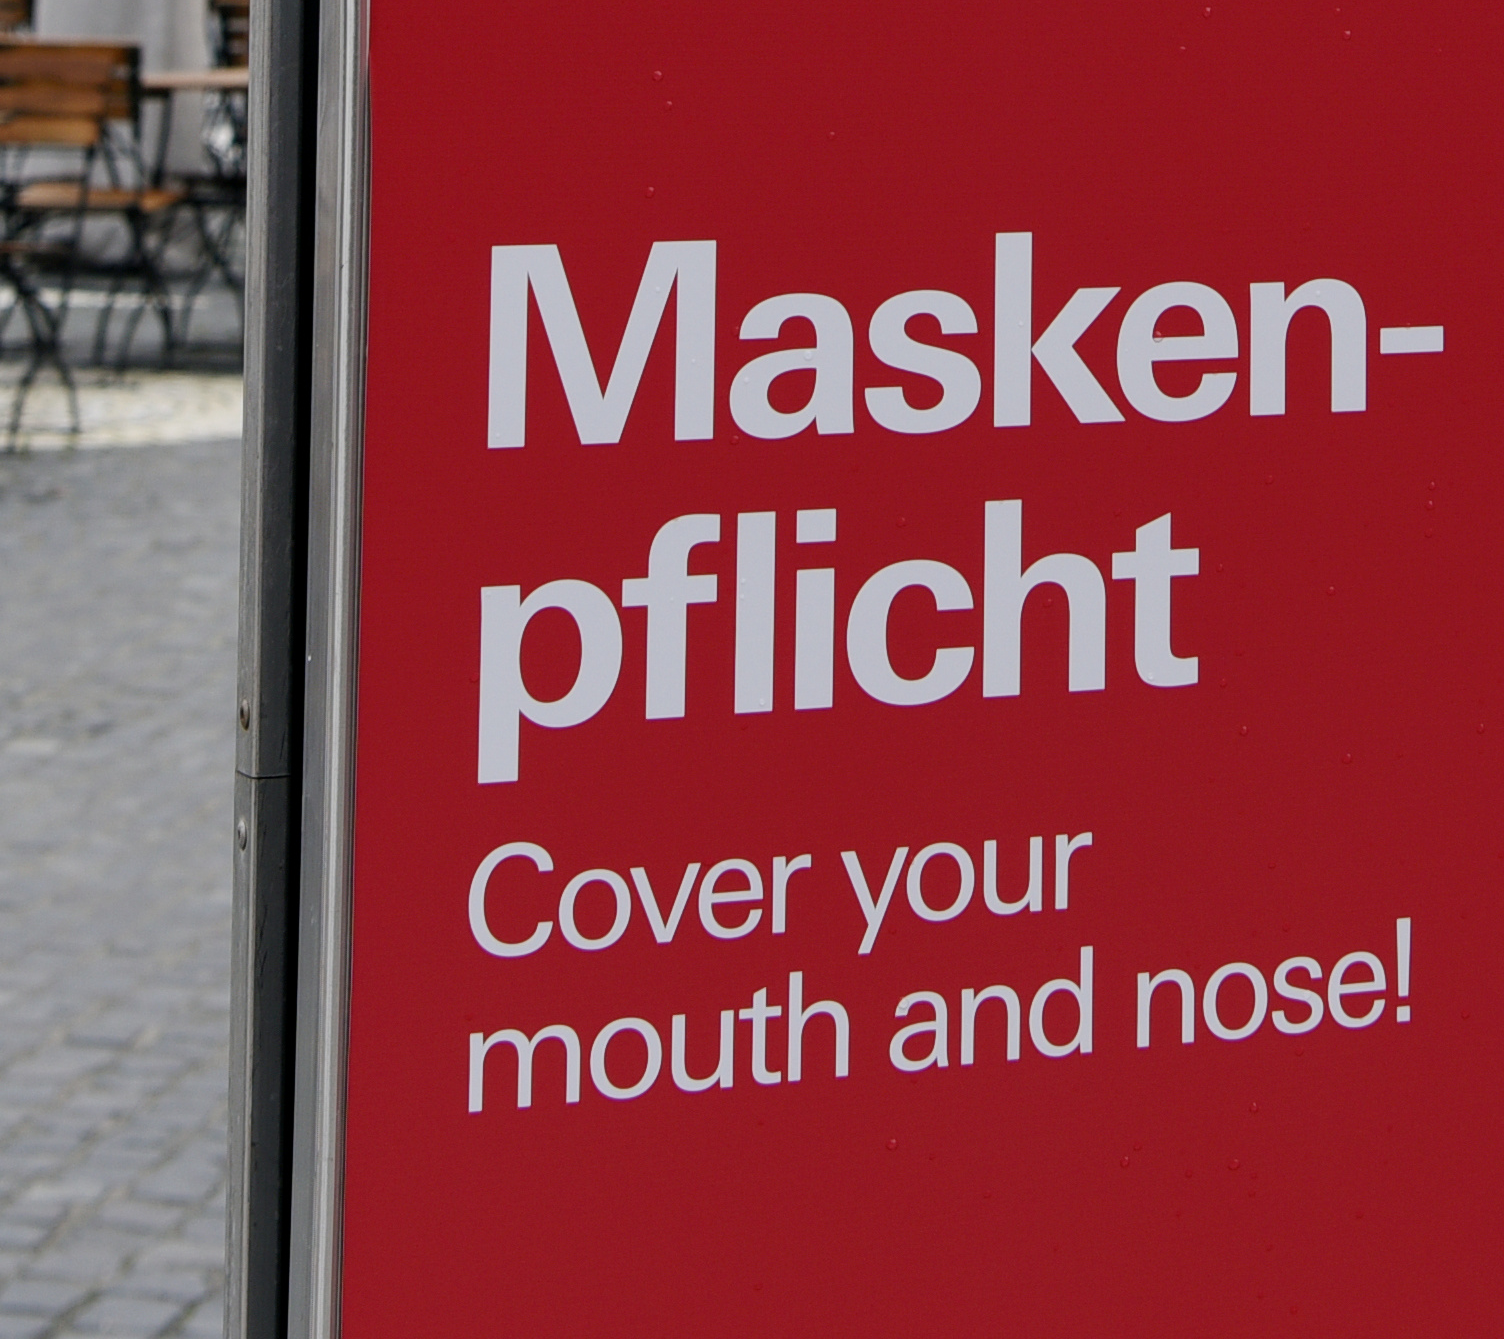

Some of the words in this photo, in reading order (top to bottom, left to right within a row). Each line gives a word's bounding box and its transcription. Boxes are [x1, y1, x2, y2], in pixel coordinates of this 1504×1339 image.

[486, 231, 1445, 449] Masken-
[477, 499, 1200, 785] pflicht
[468, 841, 812, 959] Cover
[840, 831, 1094, 955] your
[468, 970, 851, 1114] mouth
[887, 945, 1095, 1073] and
[1135, 917, 1413, 1048] nose!
